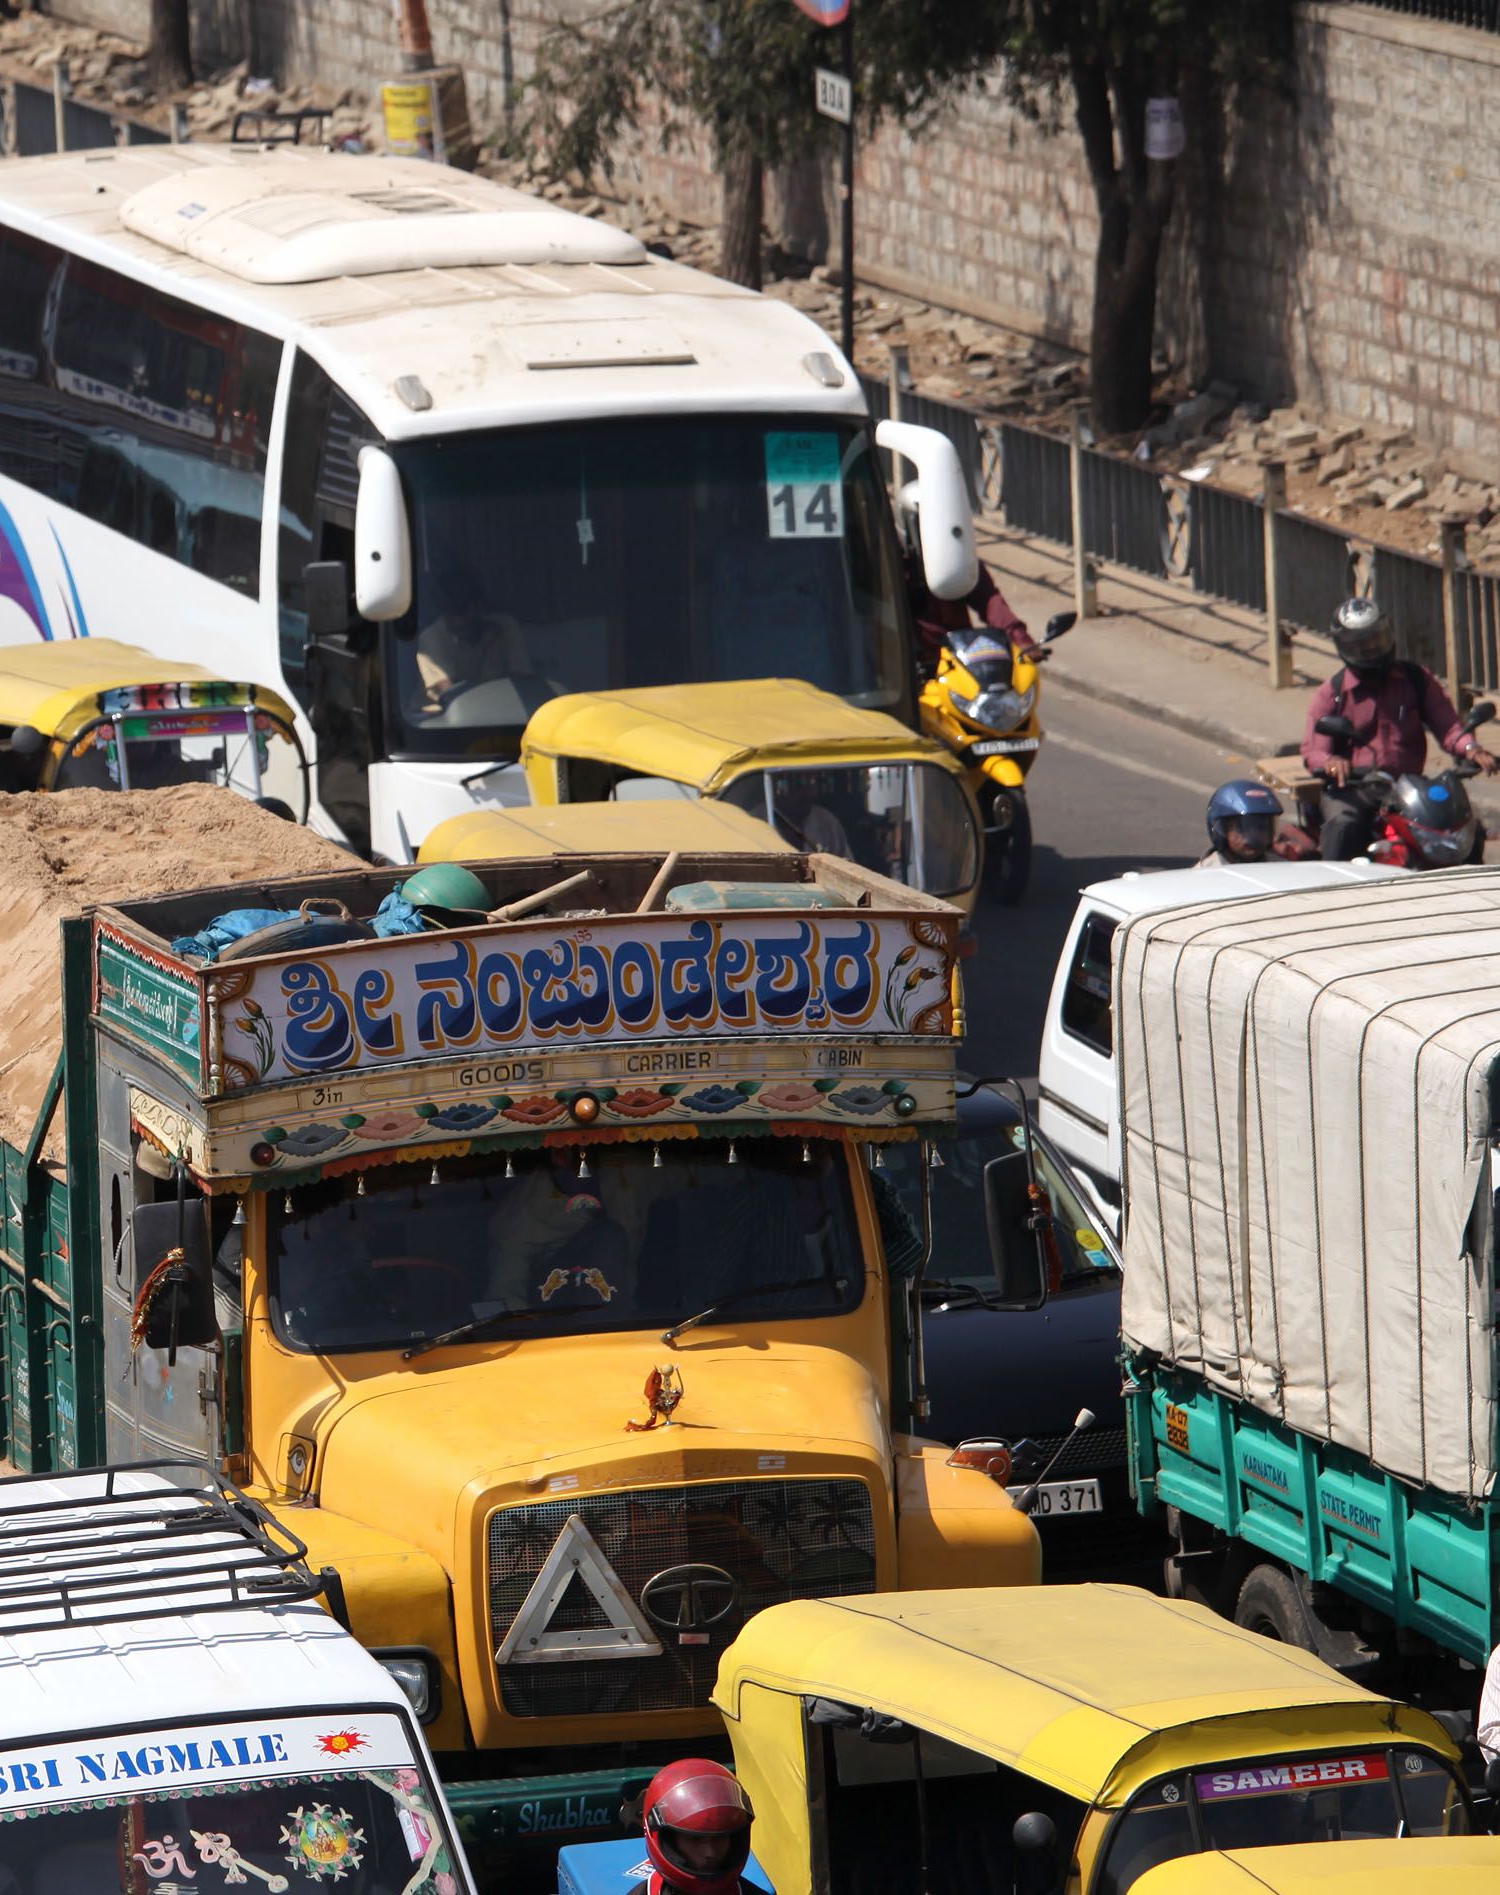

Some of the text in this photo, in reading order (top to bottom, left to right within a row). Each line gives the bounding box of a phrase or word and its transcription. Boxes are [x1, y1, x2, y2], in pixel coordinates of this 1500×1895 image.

[773, 484, 837, 533] 14
[280, 960, 405, 1075] ಶ್ರೀ
[460, 1061, 544, 1086] GOODS
[627, 1050, 712, 1074] CARRIER
[1242, 1452, 1289, 1489] KARNATAKA
[1060, 1485, 1097, 1512] 371
[1320, 1489, 1381, 1533] STATE PERMIT
[76, 1733, 289, 1784] NAGMALE
[1212, 1760, 1368, 1793] SAMEER
[517, 1797, 612, 1835] Shubha
